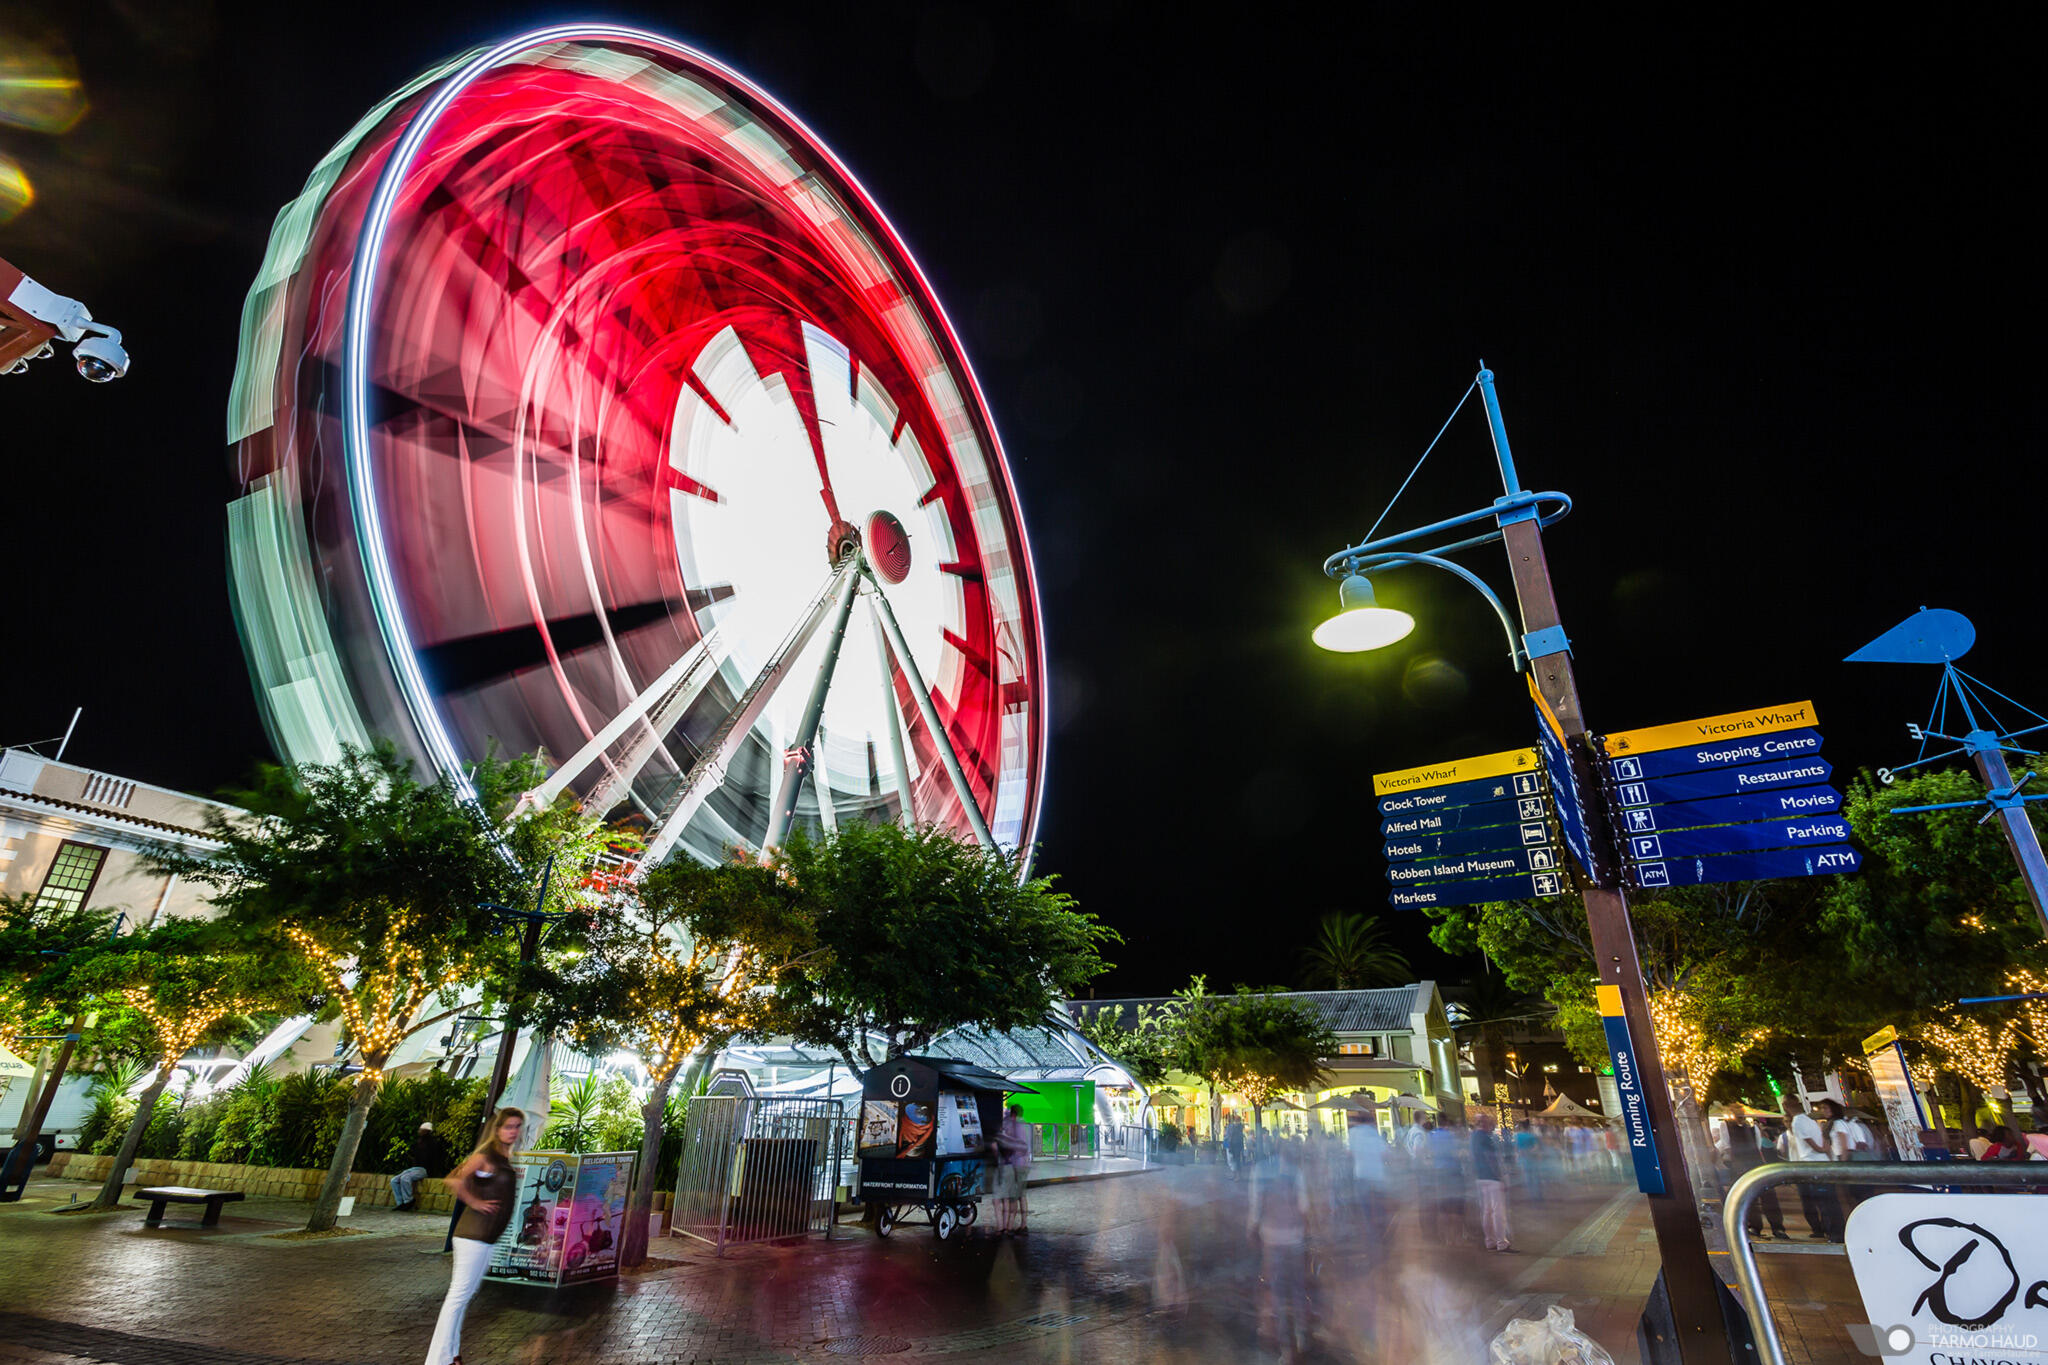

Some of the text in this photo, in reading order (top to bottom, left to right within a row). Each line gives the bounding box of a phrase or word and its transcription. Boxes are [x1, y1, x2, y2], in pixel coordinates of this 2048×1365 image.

[1697, 709, 1806, 736] Victoria Wharf
[1696, 738, 1817, 764] Shopping Centre
[1380, 767, 1457, 789] Victoria Wharf
[1737, 765, 1825, 786] Restaurants
[1383, 794, 1447, 812] Clock Tower
[1780, 794, 1835, 809] Movies
[1385, 816, 1442, 834] Alfred Mall
[1786, 824, 1846, 839] Parking
[1387, 843, 1423, 857] Hotels
[1817, 852, 1856, 868] ATM
[1390, 858, 1516, 880] Robben Island Museum
[1644, 870, 1665, 880] ATM
[1393, 892, 1437, 905] Markets
[1617, 1051, 1647, 1147] Running Route
[583, 1156, 616, 1165] HELICOPTER
[863, 1181, 928, 1190] WATERFRONT INFORMATION
